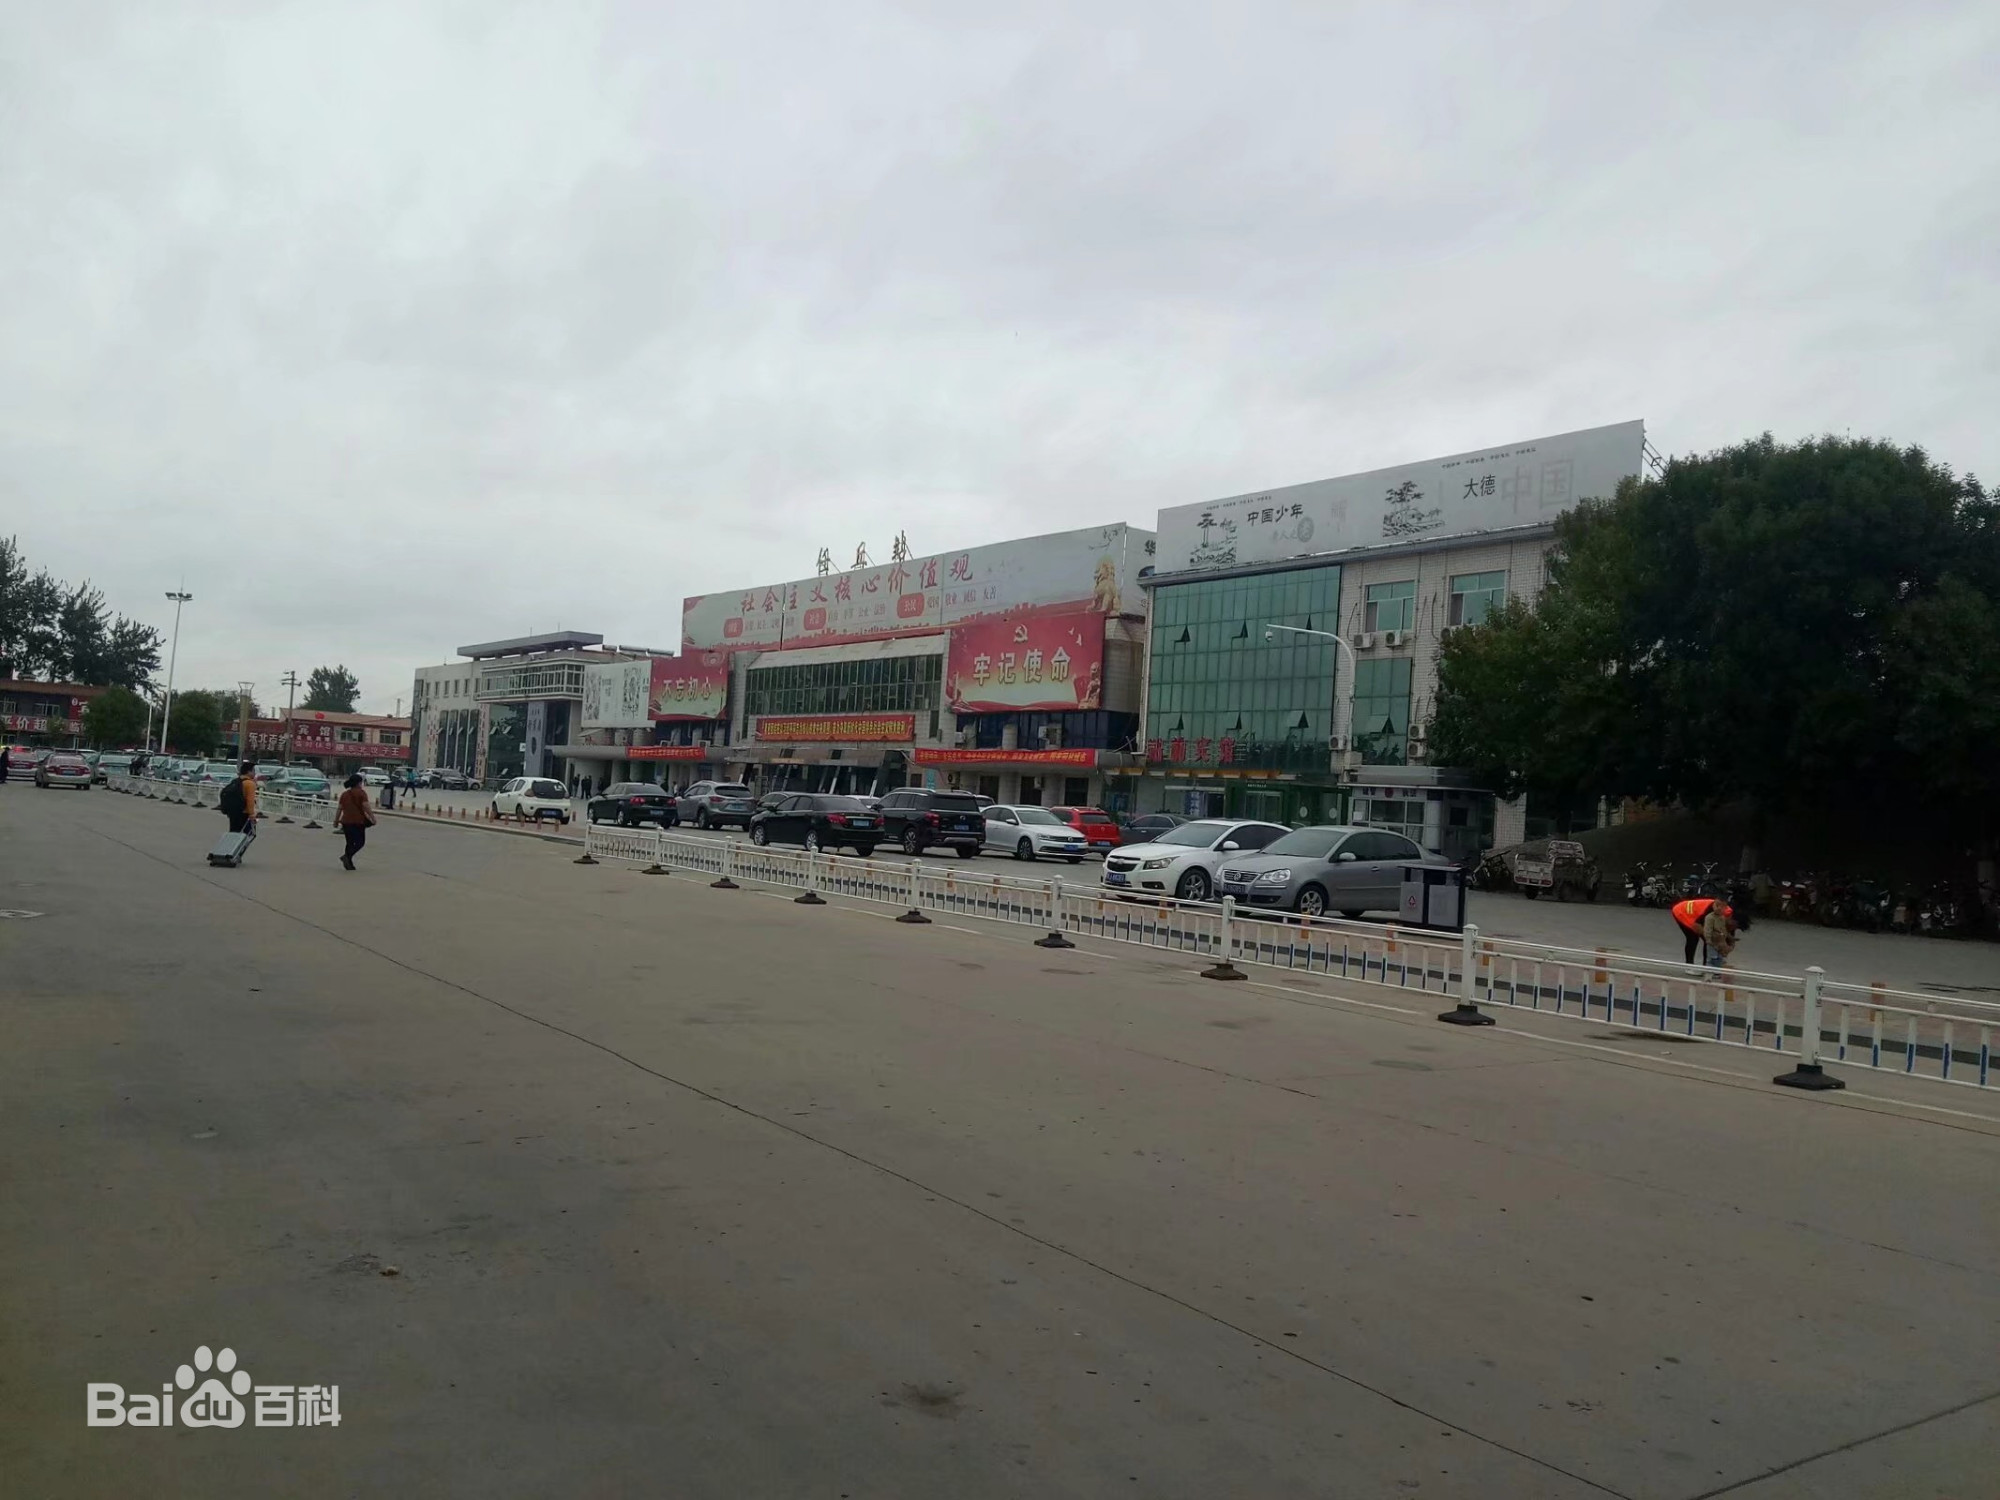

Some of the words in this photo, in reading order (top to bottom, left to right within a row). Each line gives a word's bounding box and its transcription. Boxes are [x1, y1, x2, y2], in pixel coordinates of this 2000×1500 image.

[1463, 474, 1496, 499] 大德
[1501, 458, 1575, 514] 中国
[1247, 504, 1303, 526] 中国少年
[741, 553, 973, 615] 社会主义核心价值观
[972, 647, 1072, 686] 牢记使命
[661, 677, 712, 702] 不忘初心
